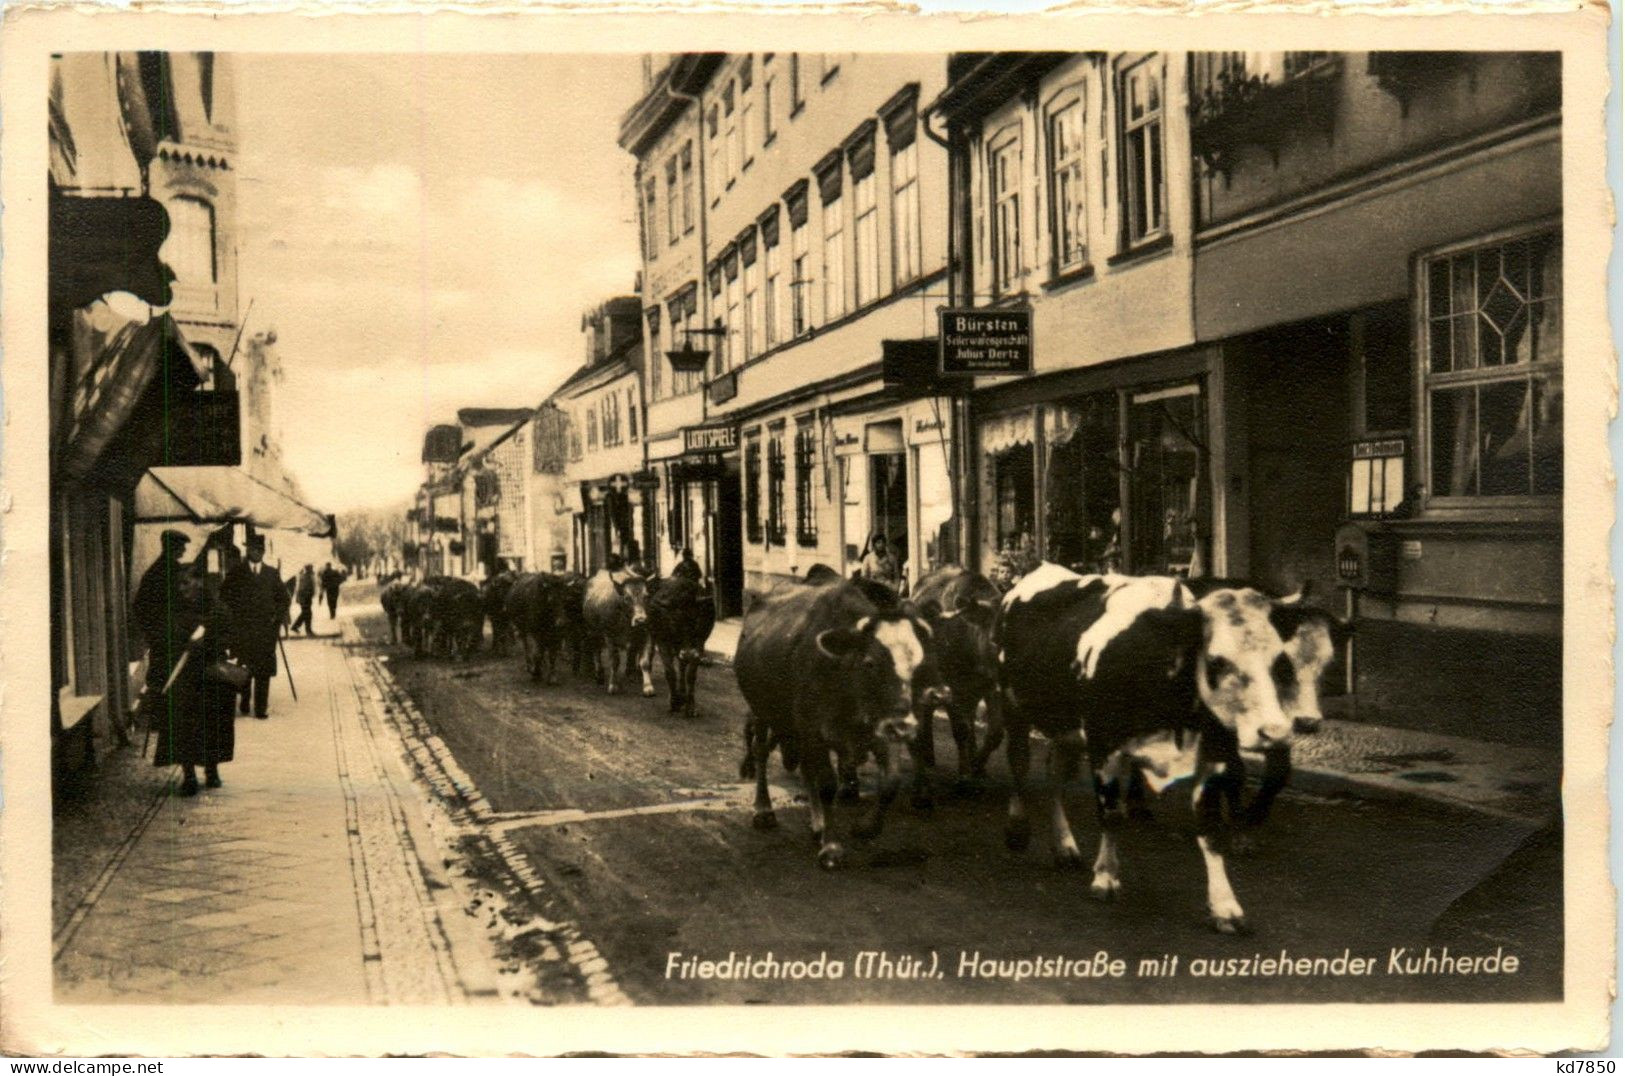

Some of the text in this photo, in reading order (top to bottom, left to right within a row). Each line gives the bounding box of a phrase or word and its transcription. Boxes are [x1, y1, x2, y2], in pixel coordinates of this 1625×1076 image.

[956, 316, 1018, 332] Bürsten
[956, 349, 985, 360] Julius
[687, 427, 736, 449] LICHTSPIELE
